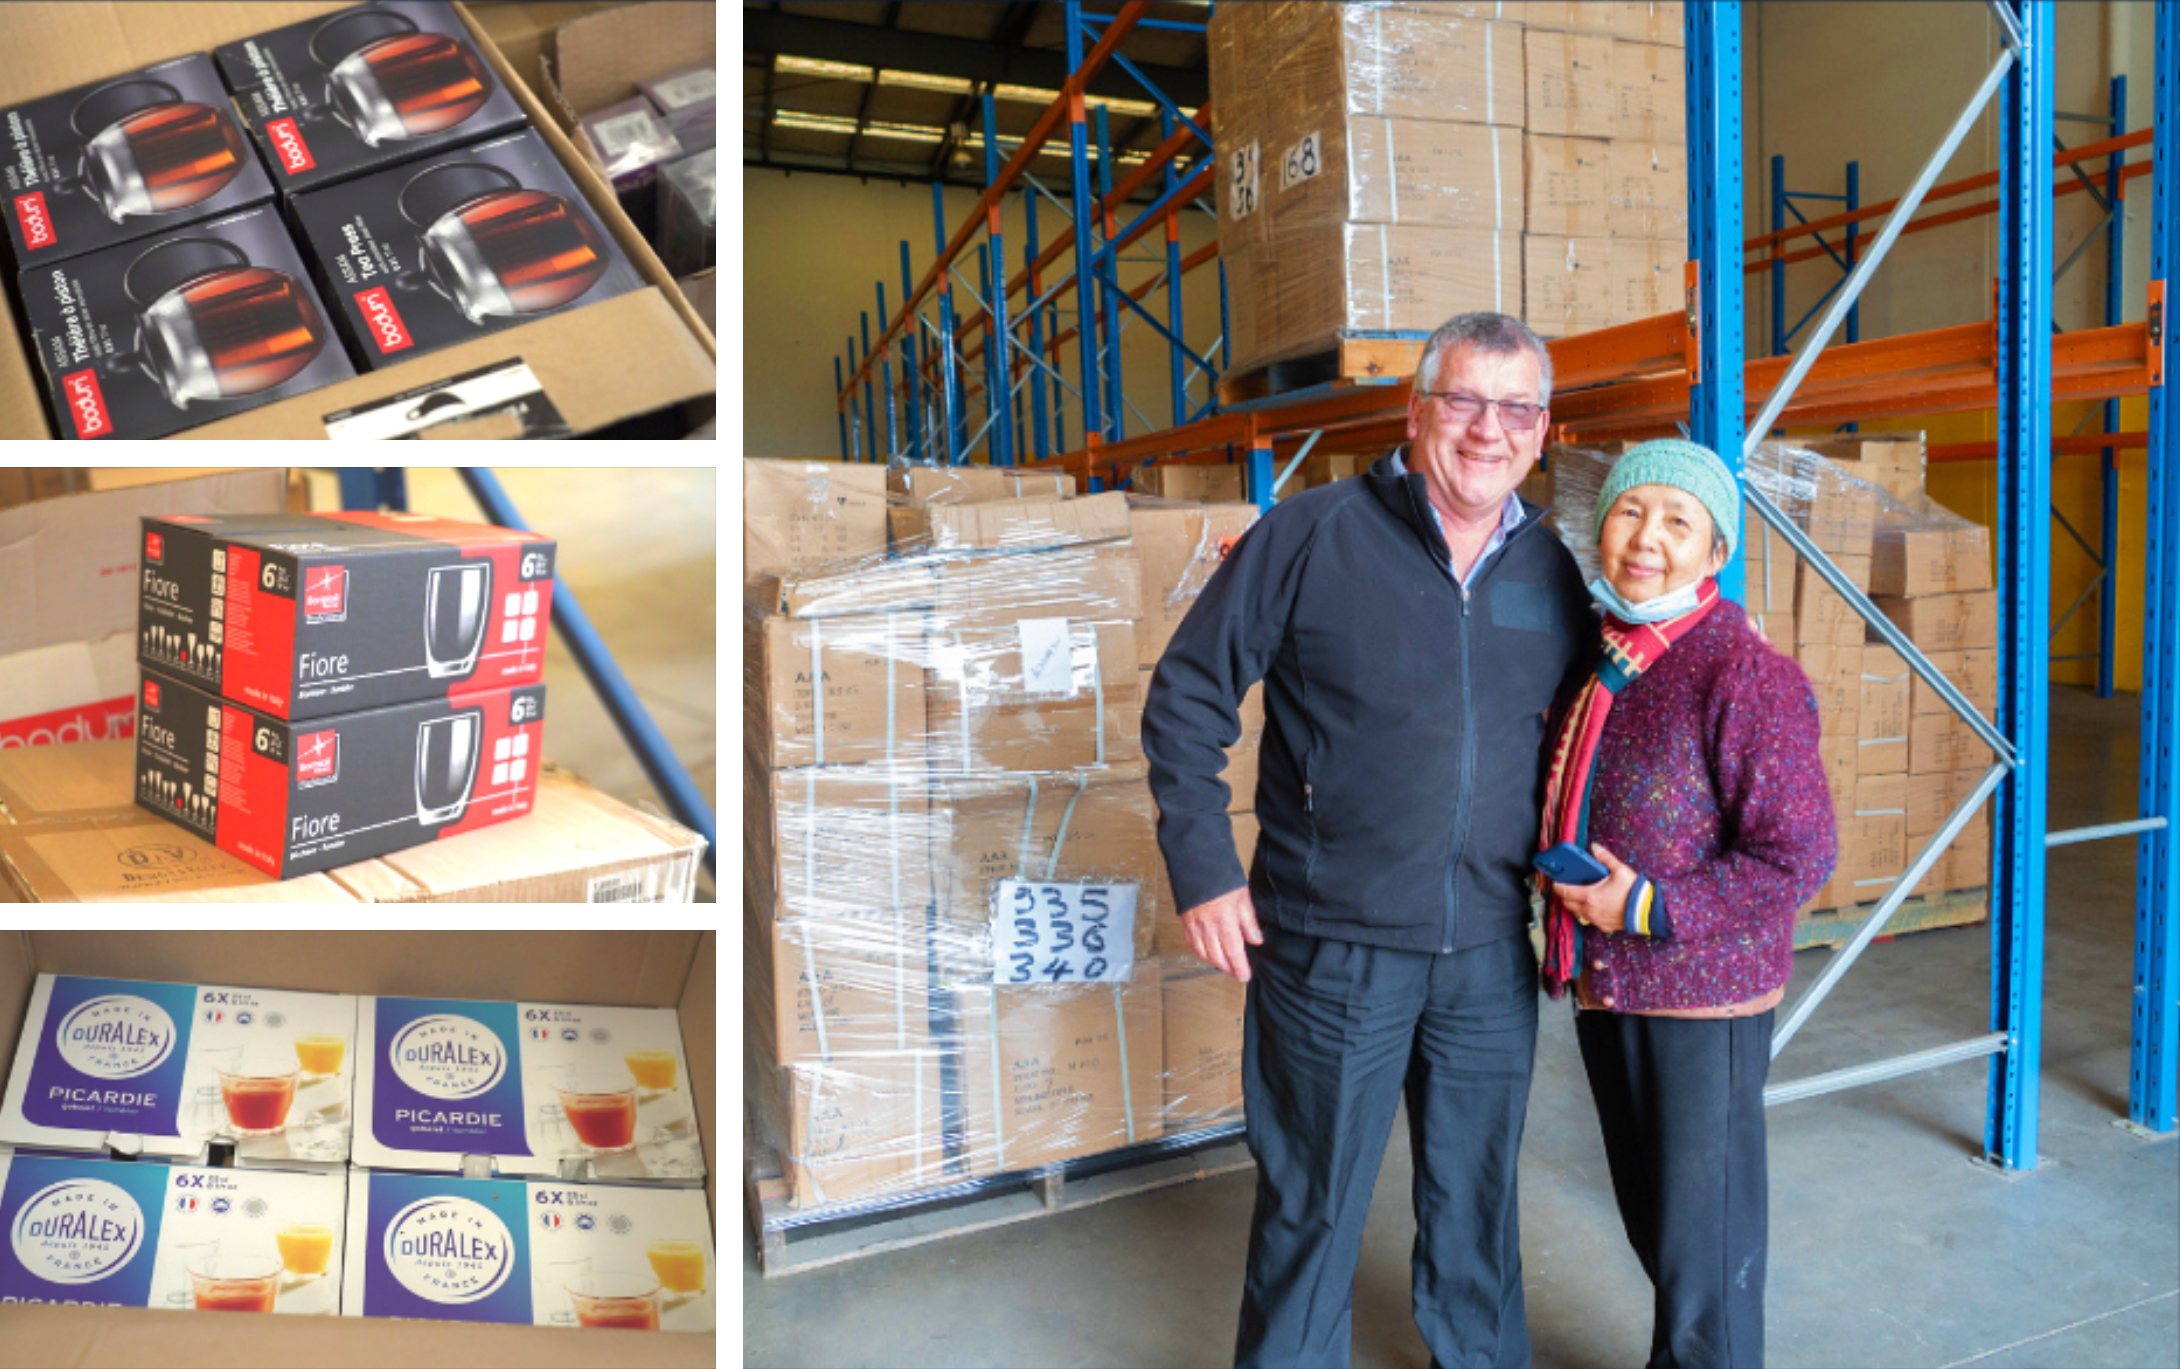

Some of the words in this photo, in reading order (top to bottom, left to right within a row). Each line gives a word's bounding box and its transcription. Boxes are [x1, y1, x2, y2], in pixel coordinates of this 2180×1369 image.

[272, 123, 306, 169] bodum
[1283, 137, 1317, 188] 168
[19, 198, 48, 244] bodum
[341, 223, 366, 256] Press
[358, 256, 378, 280] Tea
[361, 293, 402, 346] bodum
[68, 376, 102, 433] bodum
[262, 562, 277, 588] 6
[521, 552, 536, 578] 6
[144, 568, 180, 601] Fiore
[299, 652, 349, 680] Fiore
[512, 696, 526, 722] 6
[142, 714, 176, 751] Fiore
[255, 727, 271, 751] 6
[292, 812, 341, 842] Fiore
[1009, 952, 1108, 982] 340
[203, 992, 229, 1005] 6X
[525, 1009, 551, 1022] 6X
[72, 1020, 161, 1048] DURALEX
[405, 1040, 492, 1067] DURALEX
[49, 1086, 157, 1108] PICARDIE
[395, 1109, 503, 1128] PICARDIE
[175, 1174, 205, 1188] 6X
[52, 1193, 95, 1207] MADE
[535, 1190, 563, 1205] 6X
[29, 1210, 126, 1242] DURALEX
[416, 1210, 458, 1225] MADE
[401, 1228, 498, 1261] DURALEX
[46, 1254, 102, 1270] FRANCE
[423, 1273, 479, 1289] FRANCE
